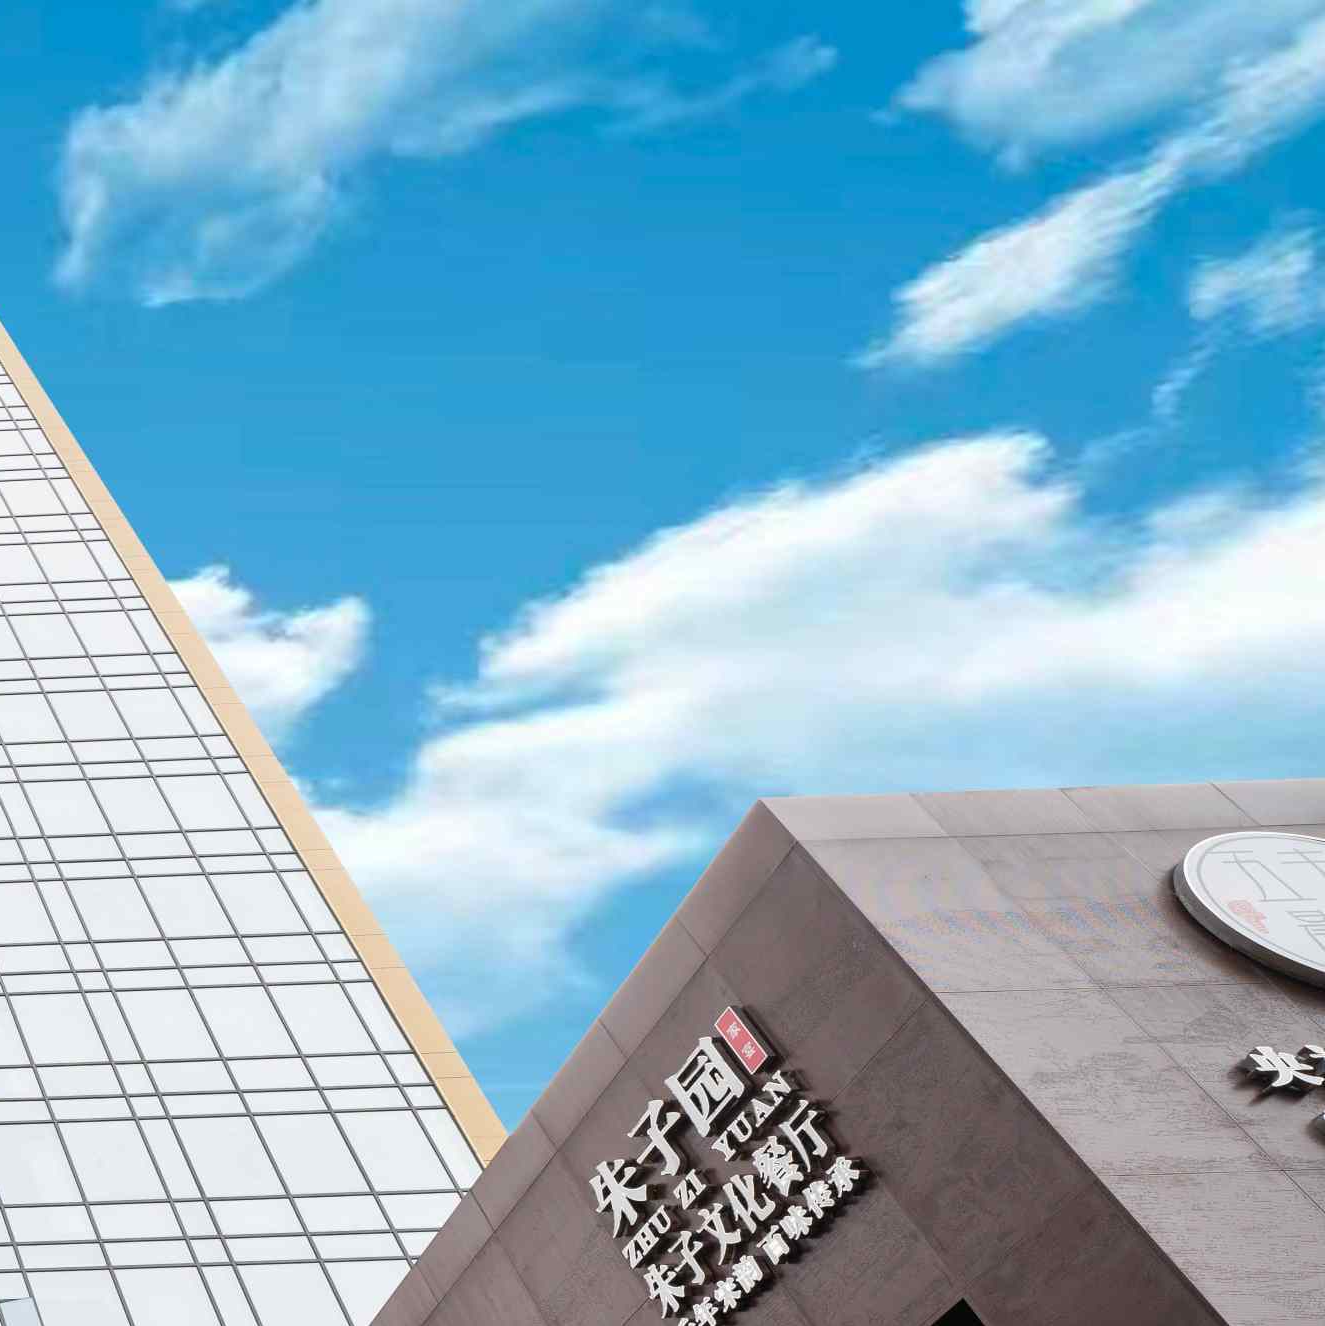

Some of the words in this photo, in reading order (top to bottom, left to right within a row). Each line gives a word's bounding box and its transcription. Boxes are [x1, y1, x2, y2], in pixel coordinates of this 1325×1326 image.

[589, 1036, 746, 1238] 朱子园
[1249, 1045, 1325, 1087] 央
[622, 1205, 673, 1269] ZHU
[673, 1168, 708, 1210] ZI
[711, 1070, 793, 1162] YUAN
[643, 1099, 829, 1319] 朱子文化餐厅
[757, 1156, 860, 1265] 百味传承
